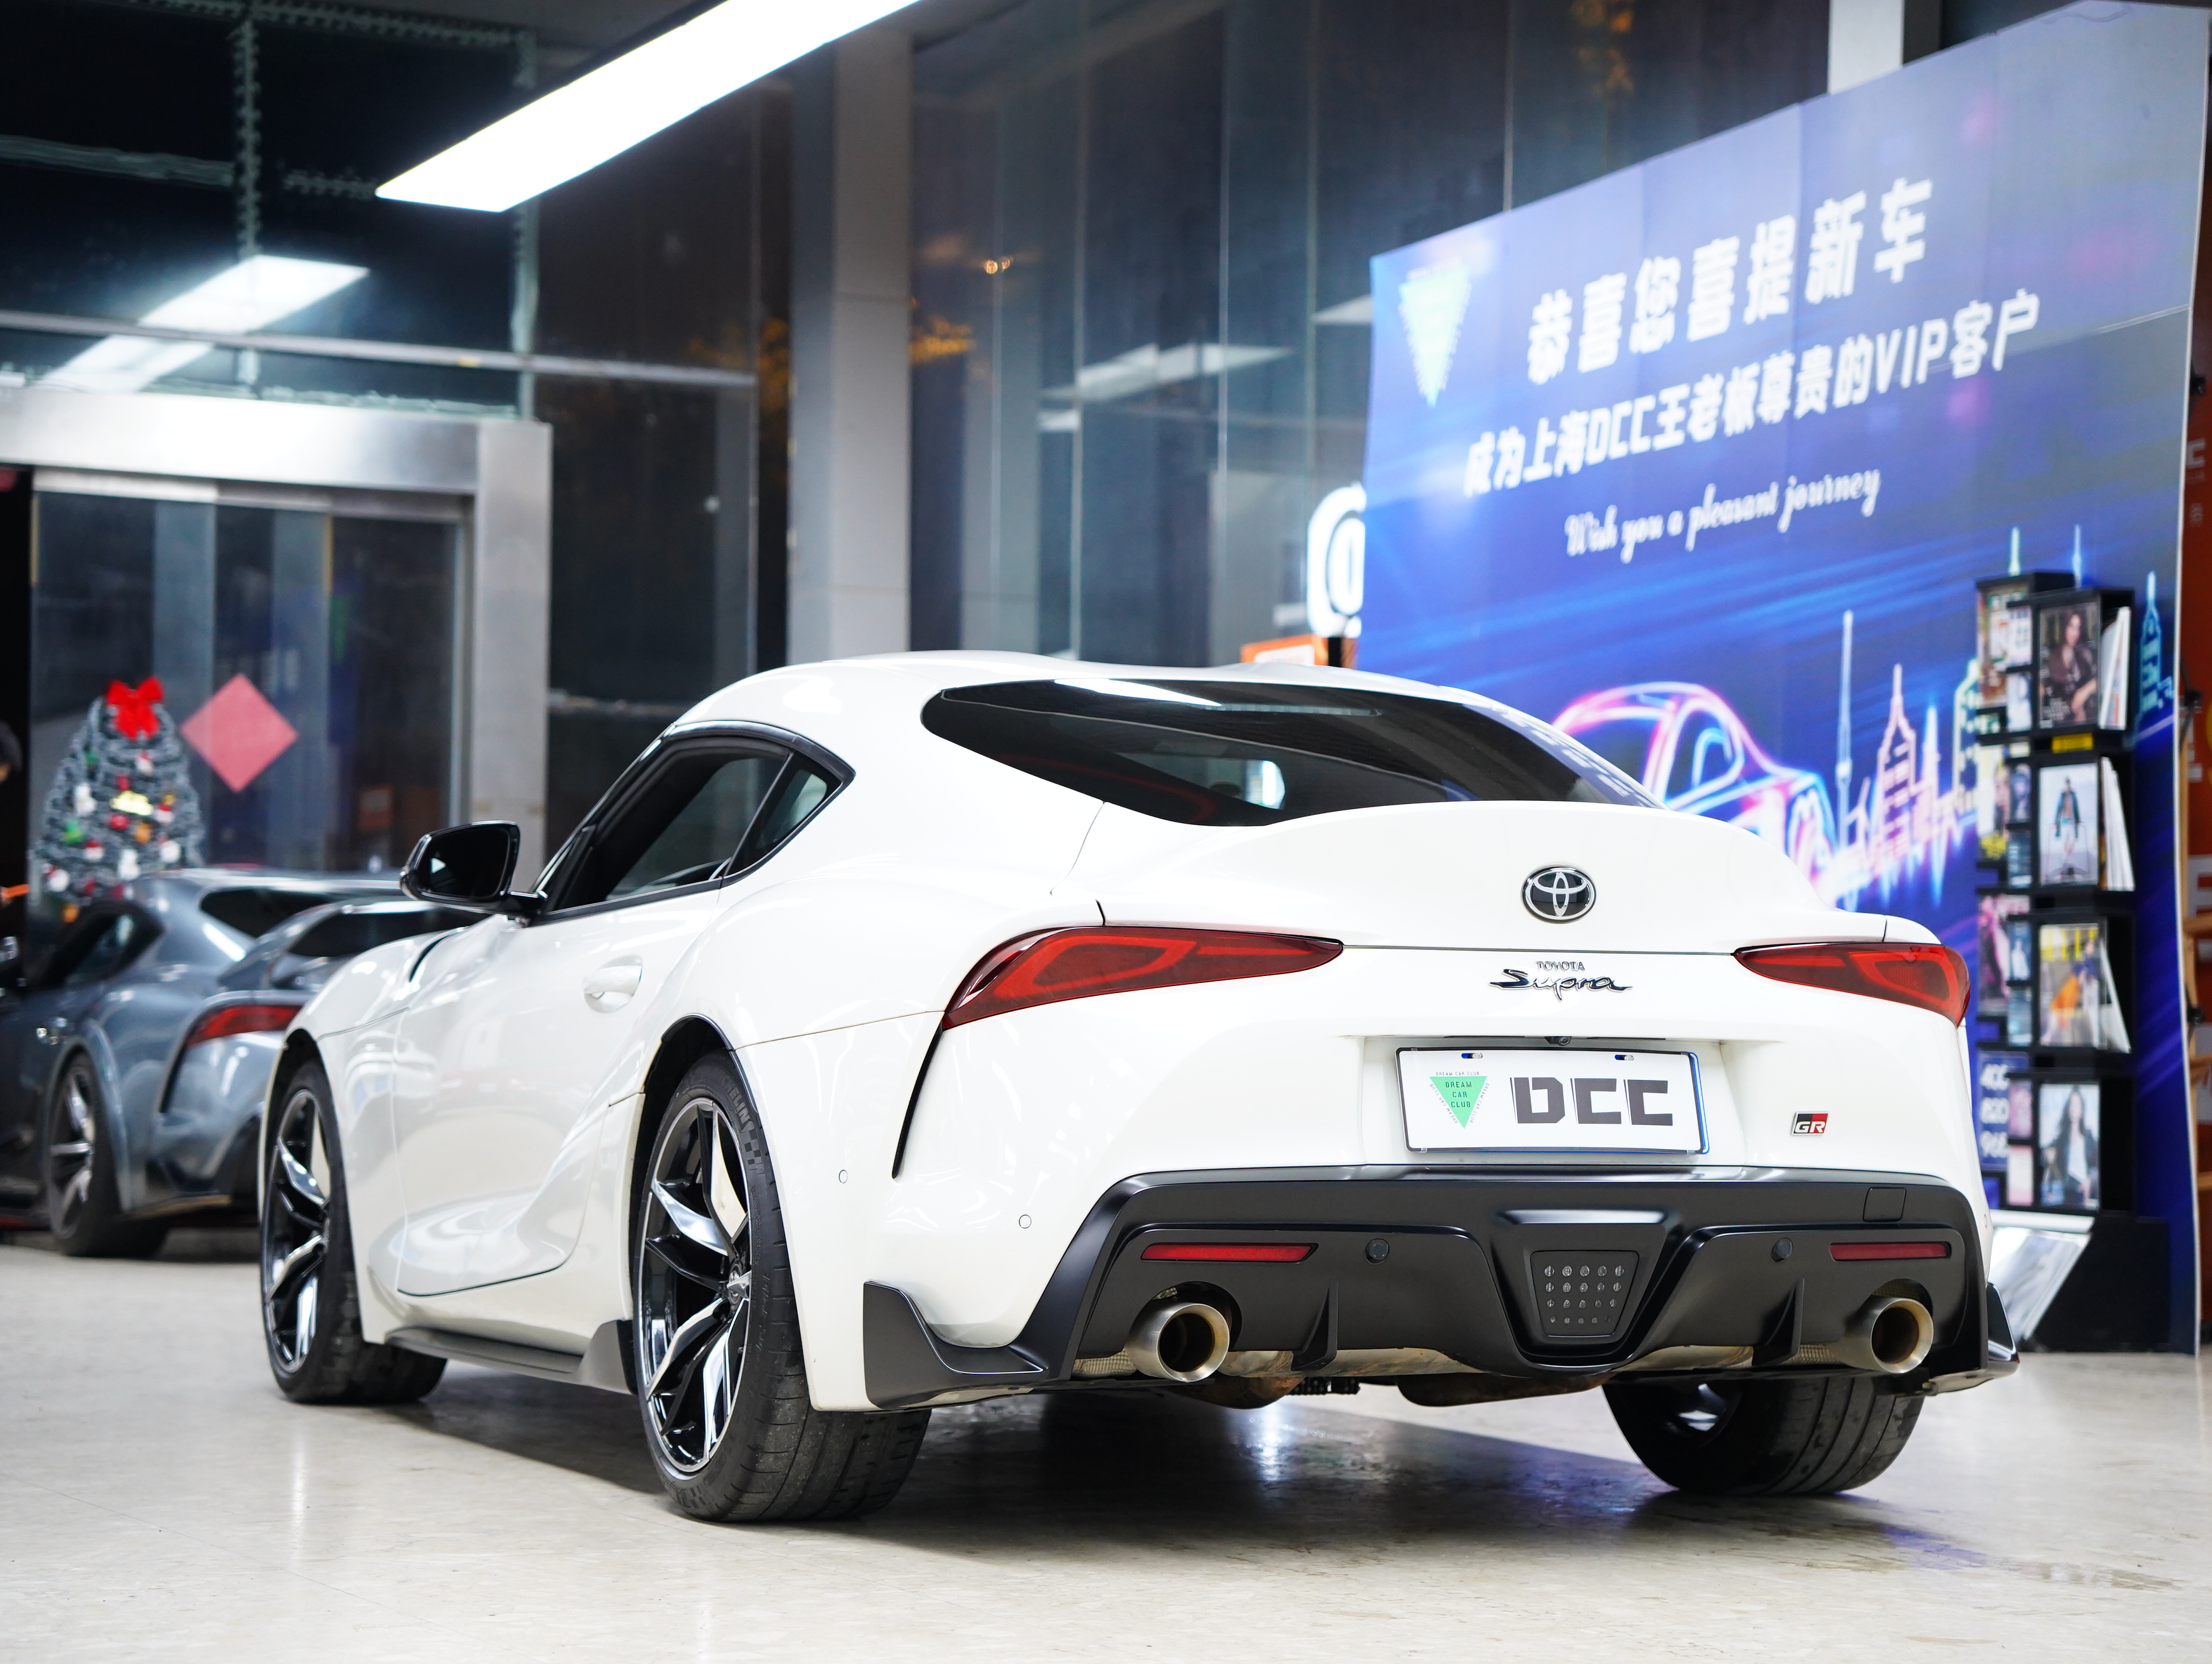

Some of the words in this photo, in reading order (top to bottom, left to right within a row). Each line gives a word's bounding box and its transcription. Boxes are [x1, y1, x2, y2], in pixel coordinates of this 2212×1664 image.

[1527, 178, 1933, 384] 恭喜您喜提新车
[1464, 288, 2041, 498] 成为上海DCC王老板尊贵的VIP客户
[1565, 504, 1618, 557] Wish
[1620, 514, 1663, 564] you
[1667, 510, 1684, 536] a
[1685, 483, 1778, 552] pleasant
[1778, 469, 1880, 533] journey
[1536, 961, 1585, 971] TOYOTA
[1489, 968, 1633, 1002] Supra
[1429, 1083, 1439, 1096] CLUB
[1480, 1082, 1490, 1099] DREAM
[1438, 1097, 1447, 1107] CAR
[1509, 1077, 1673, 1126] DCC
[1446, 1107, 1458, 1124] DREAM
[1469, 1111, 1478, 1123] CLUB
[1795, 1121, 1826, 1133] GR
